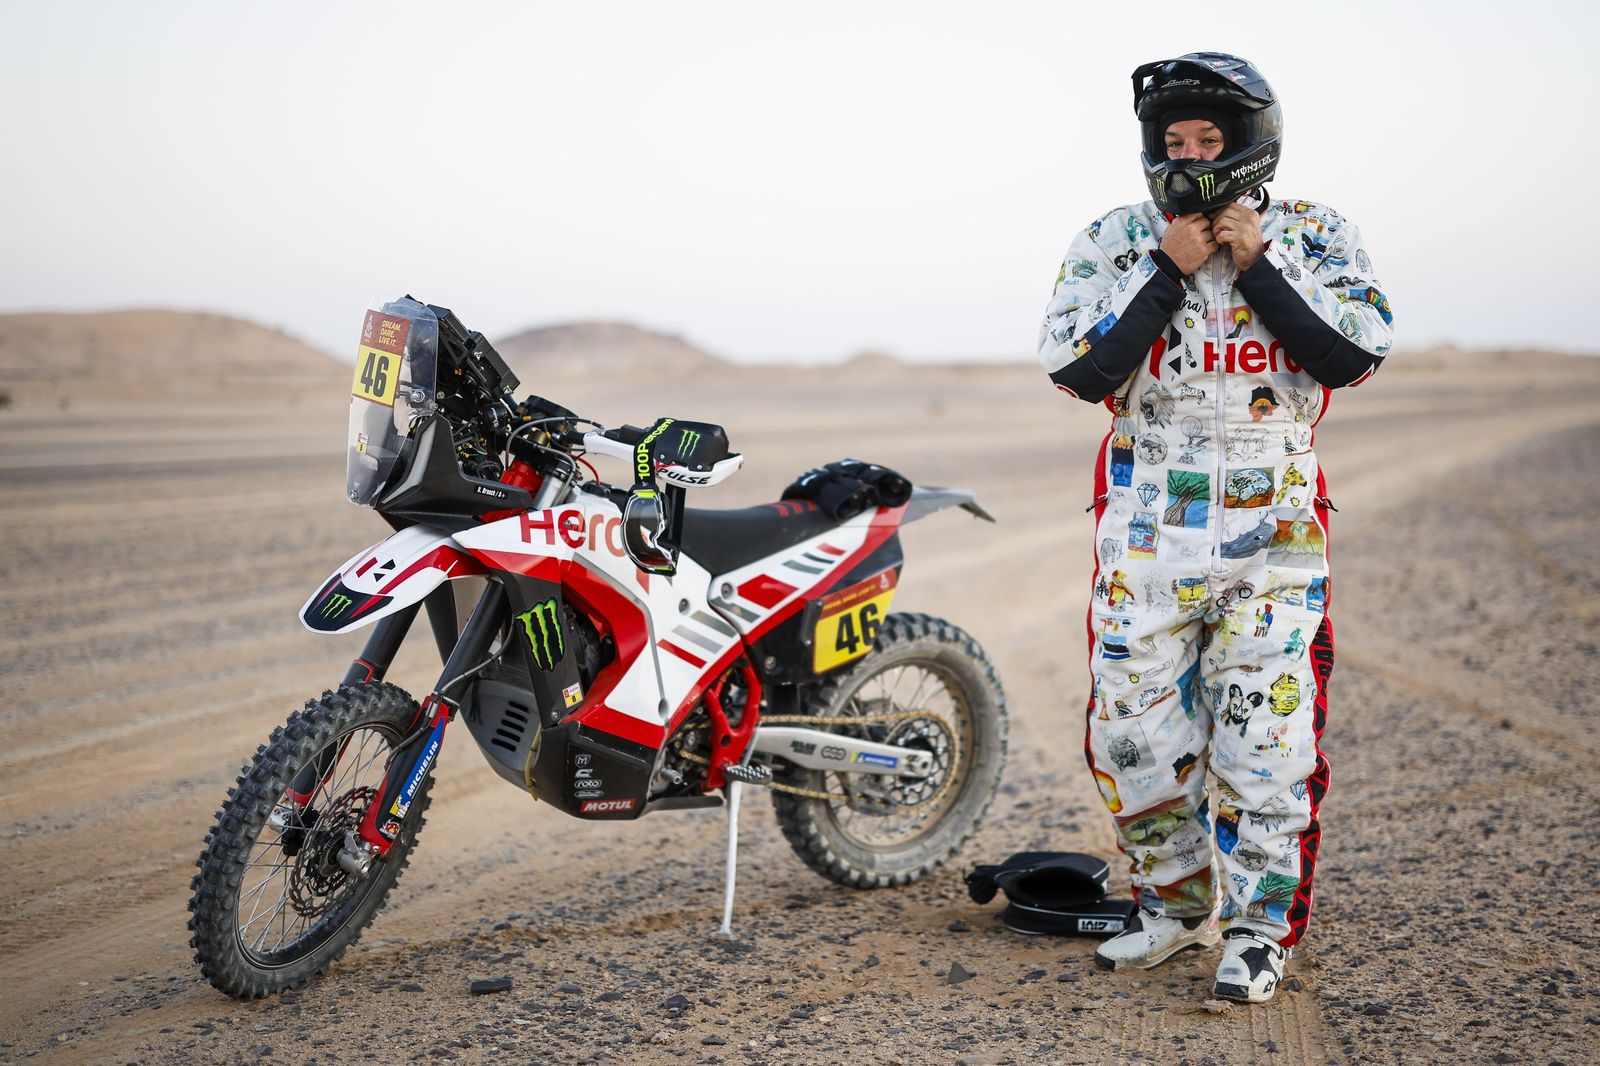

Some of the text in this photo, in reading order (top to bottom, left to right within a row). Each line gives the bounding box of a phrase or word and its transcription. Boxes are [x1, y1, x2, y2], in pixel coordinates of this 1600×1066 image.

[1230, 154, 1274, 180] MONSTER
[360, 352, 390, 398] 46
[636, 418, 675, 480] 100Percent
[656, 467, 712, 485] PULSE
[835, 602, 881, 655] 46
[407, 740, 439, 797] MICHELIN
[583, 800, 632, 812] MOTUL
